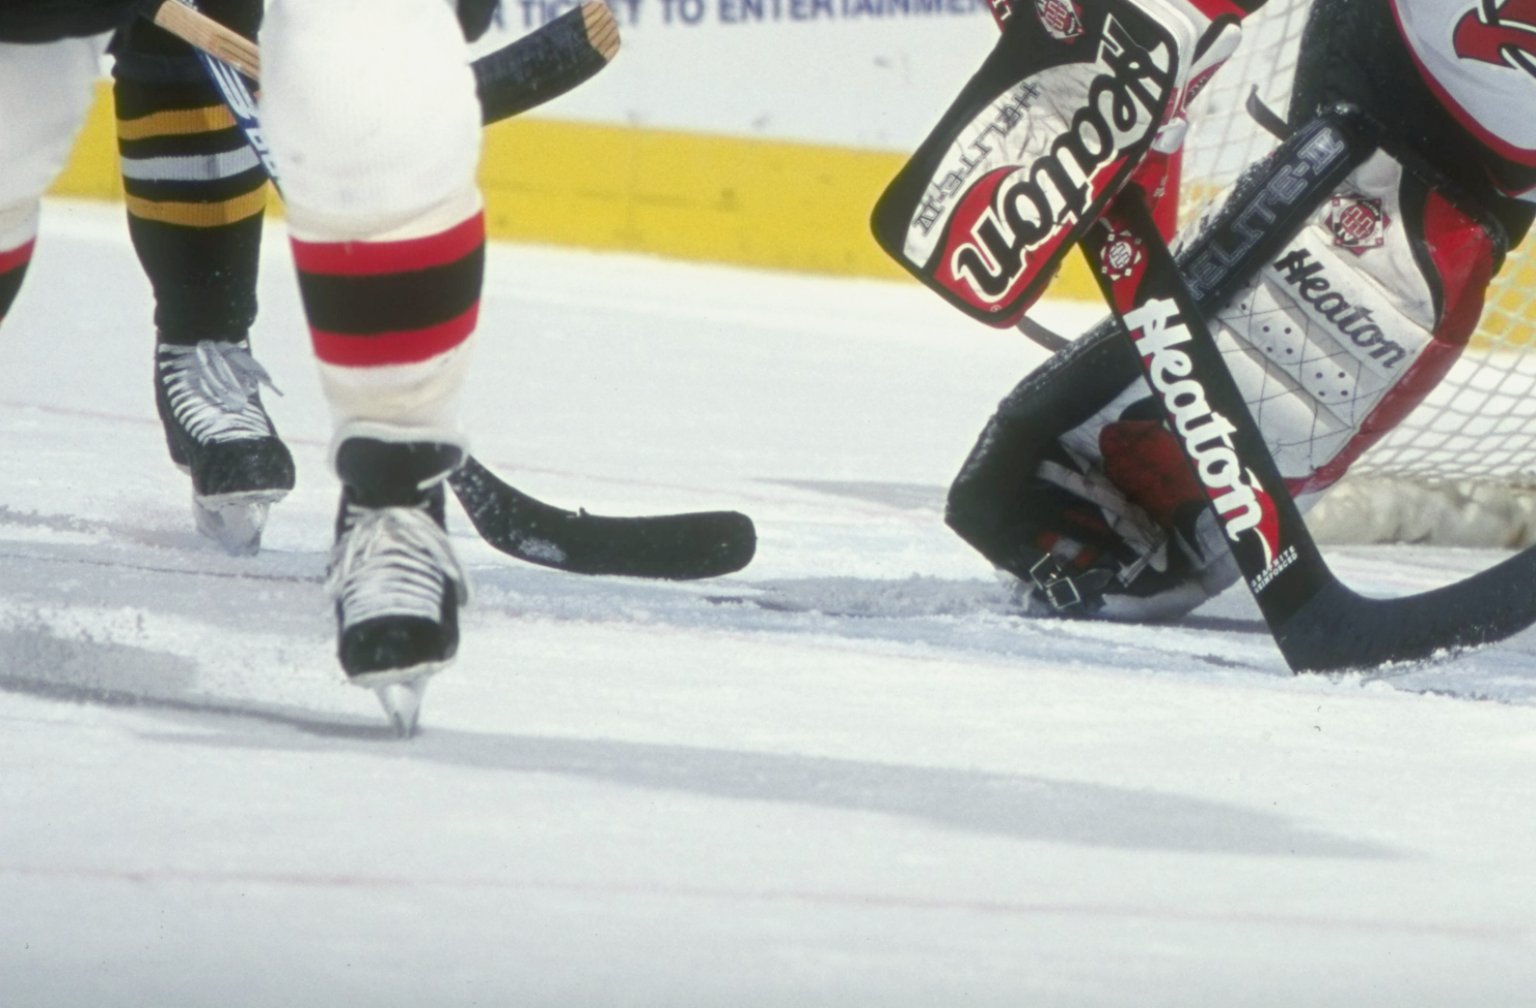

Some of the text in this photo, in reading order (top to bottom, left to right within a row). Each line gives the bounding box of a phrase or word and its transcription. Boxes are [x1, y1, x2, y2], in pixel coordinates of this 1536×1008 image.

[951, 12, 1175, 304] Heaton
[1123, 297, 1263, 543] Heaton
[1272, 247, 1407, 370] Heaton
